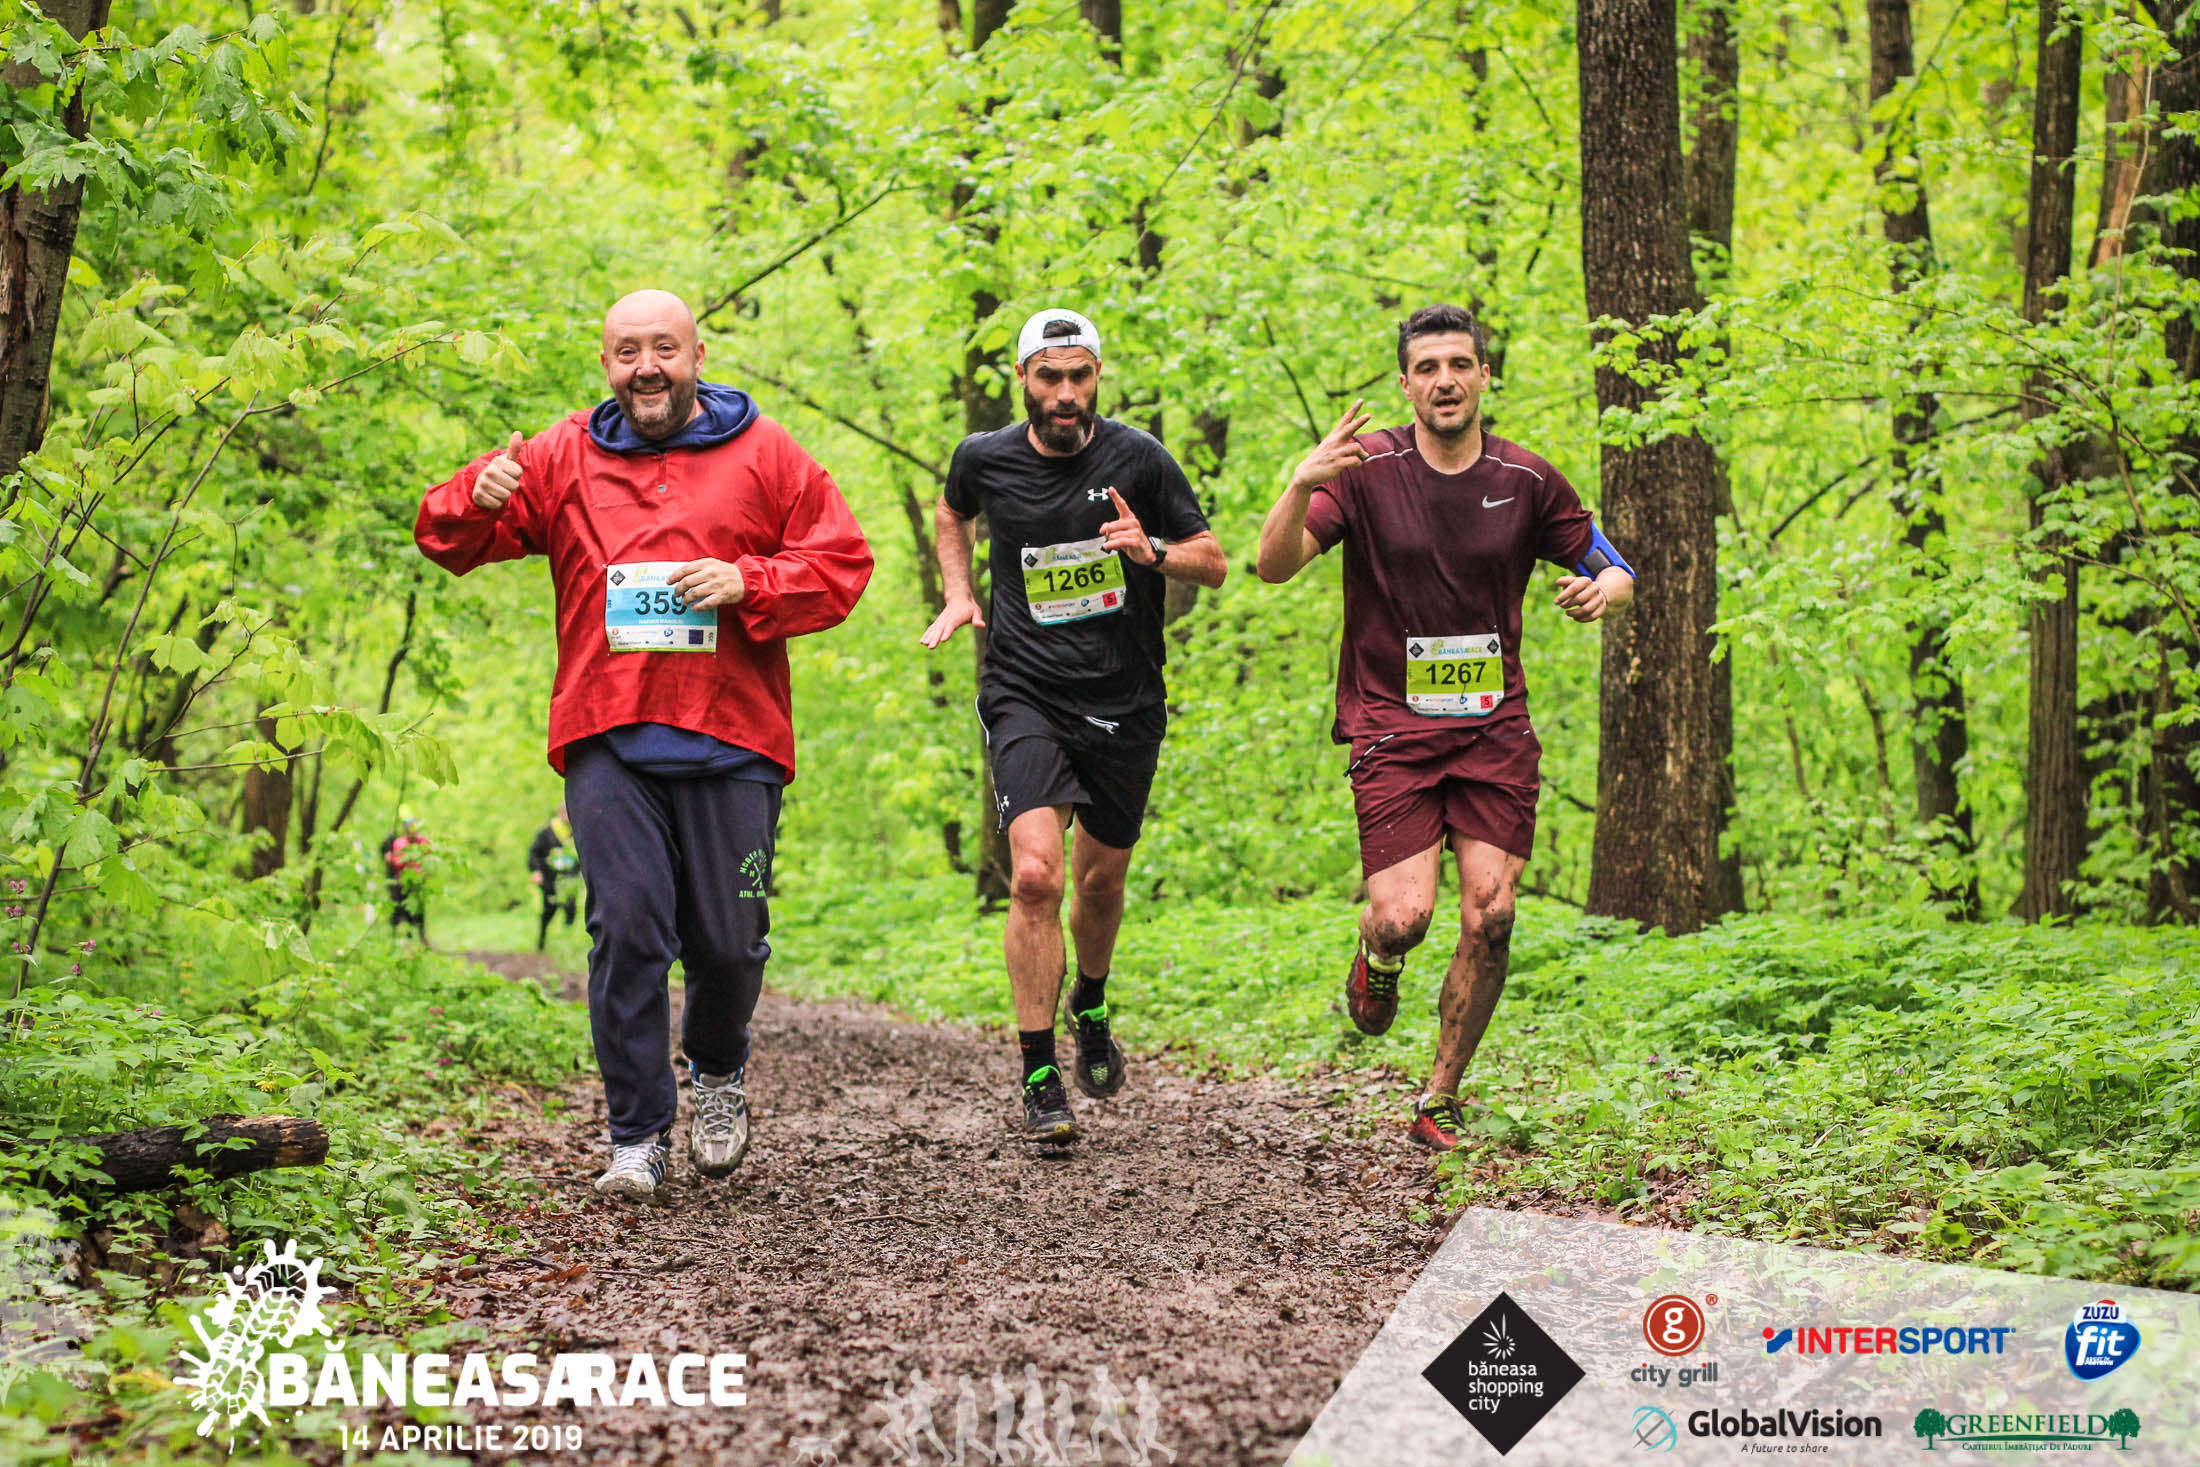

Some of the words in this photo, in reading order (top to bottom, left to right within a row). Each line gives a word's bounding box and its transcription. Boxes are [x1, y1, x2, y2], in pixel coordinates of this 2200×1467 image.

[1044, 563, 1105, 592] 1266
[635, 590, 688, 615] 359
[1426, 661, 1486, 685] 1267
